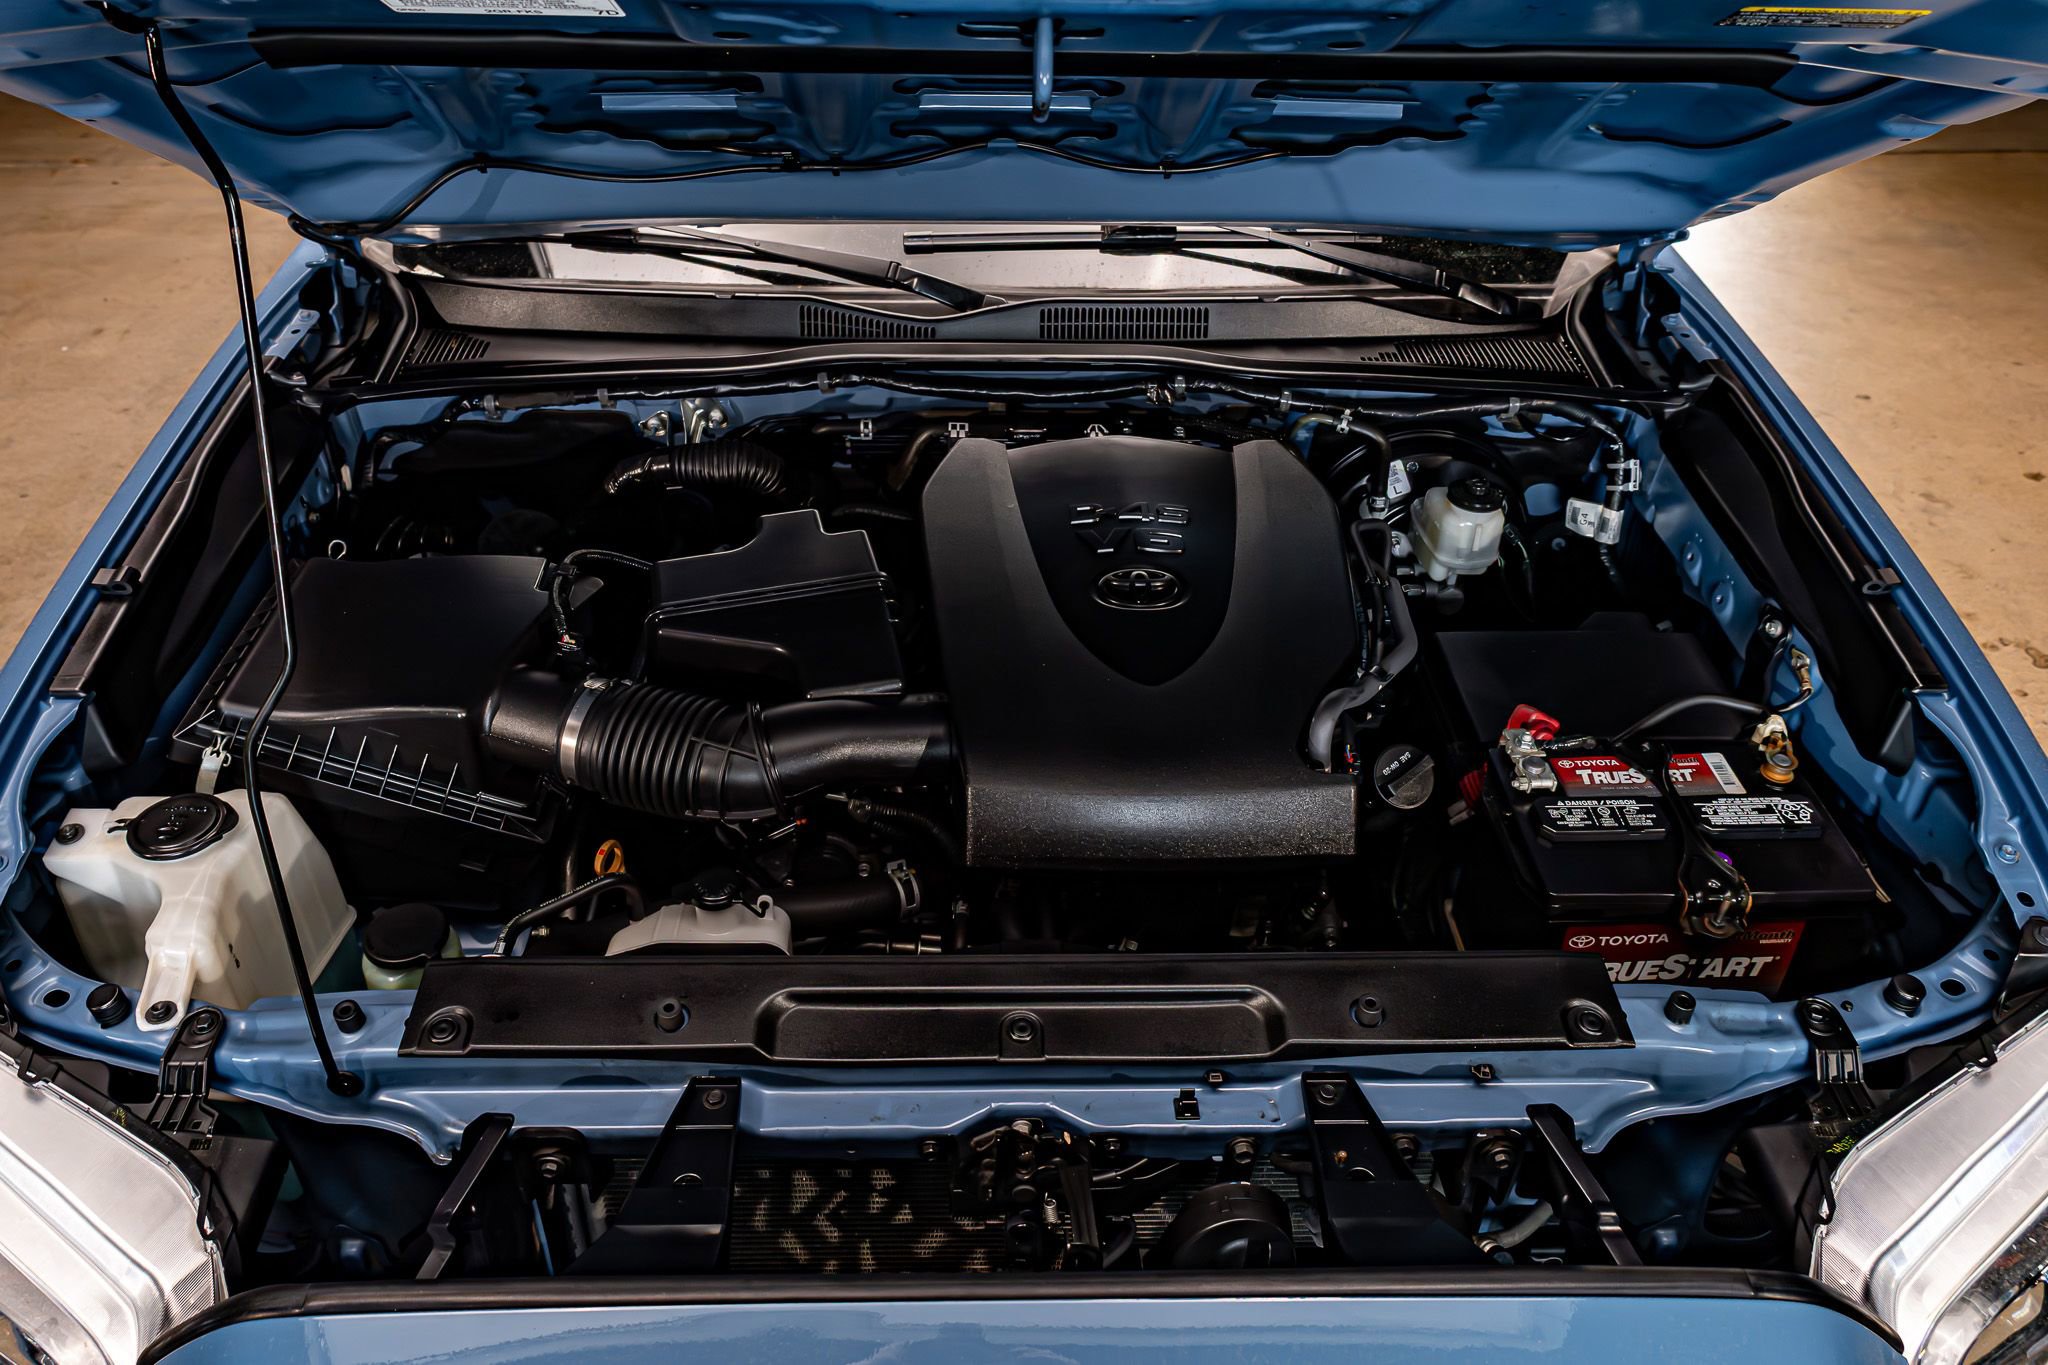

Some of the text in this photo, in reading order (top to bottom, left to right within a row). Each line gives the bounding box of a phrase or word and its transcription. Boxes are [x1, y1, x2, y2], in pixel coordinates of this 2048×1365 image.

[1393, 485, 1403, 495] L
[1073, 527, 1184, 554] V6
[1574, 759, 1620, 767] TOYOTA
[1599, 933, 1669, 947] TOYOTA
[1604, 953, 1775, 982] RUESART
